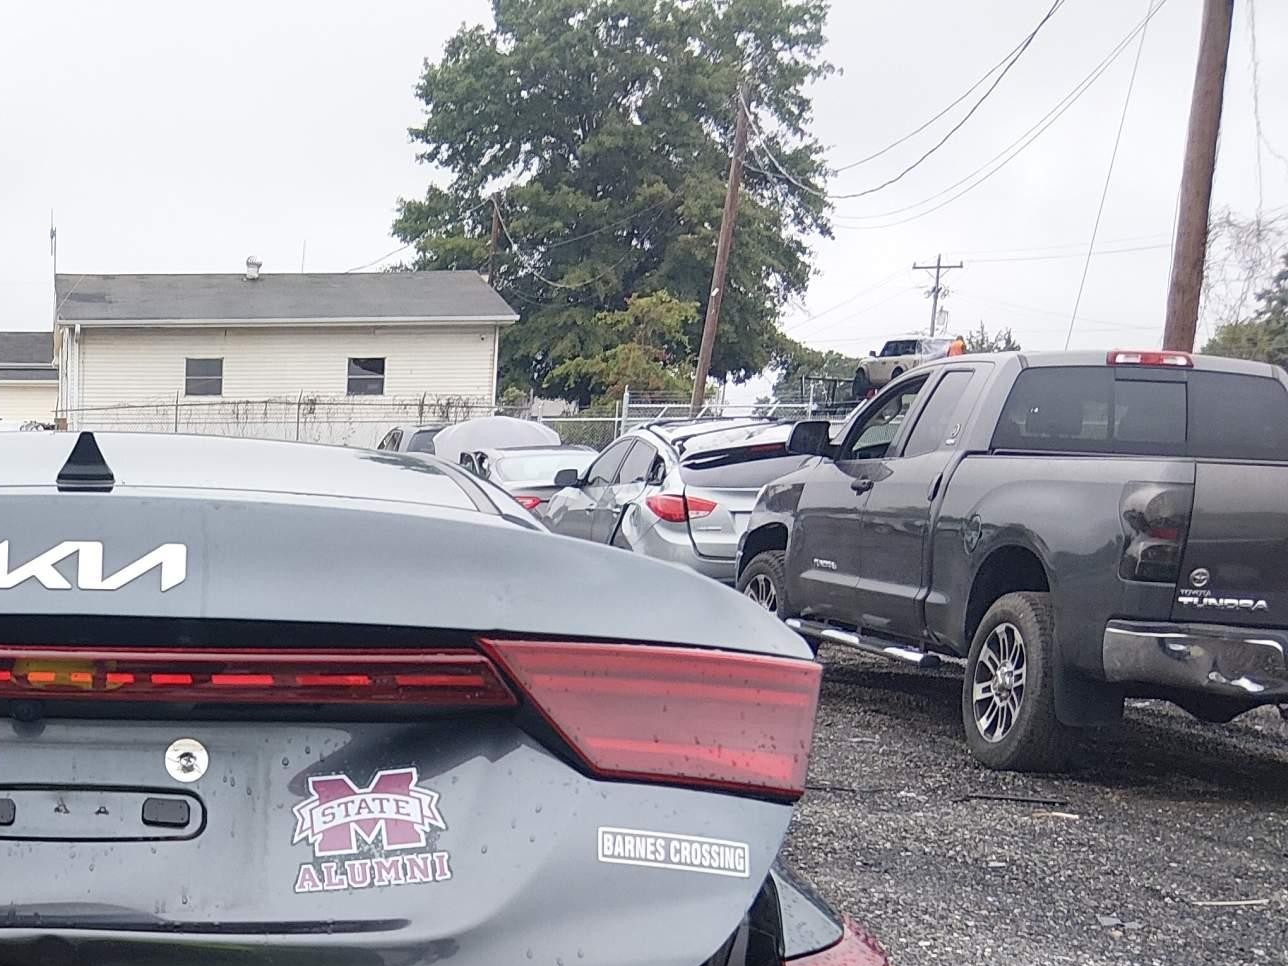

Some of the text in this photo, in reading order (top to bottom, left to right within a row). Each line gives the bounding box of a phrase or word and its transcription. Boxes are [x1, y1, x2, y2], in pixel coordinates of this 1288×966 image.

[1177, 596, 1269, 611] TUNDRA
[1179, 588, 1212, 597] TOYOTA
[320, 796, 411, 824] STATE
[603, 832, 745, 871] BARNES CROSSING
[295, 852, 452, 892] ALUMNI
